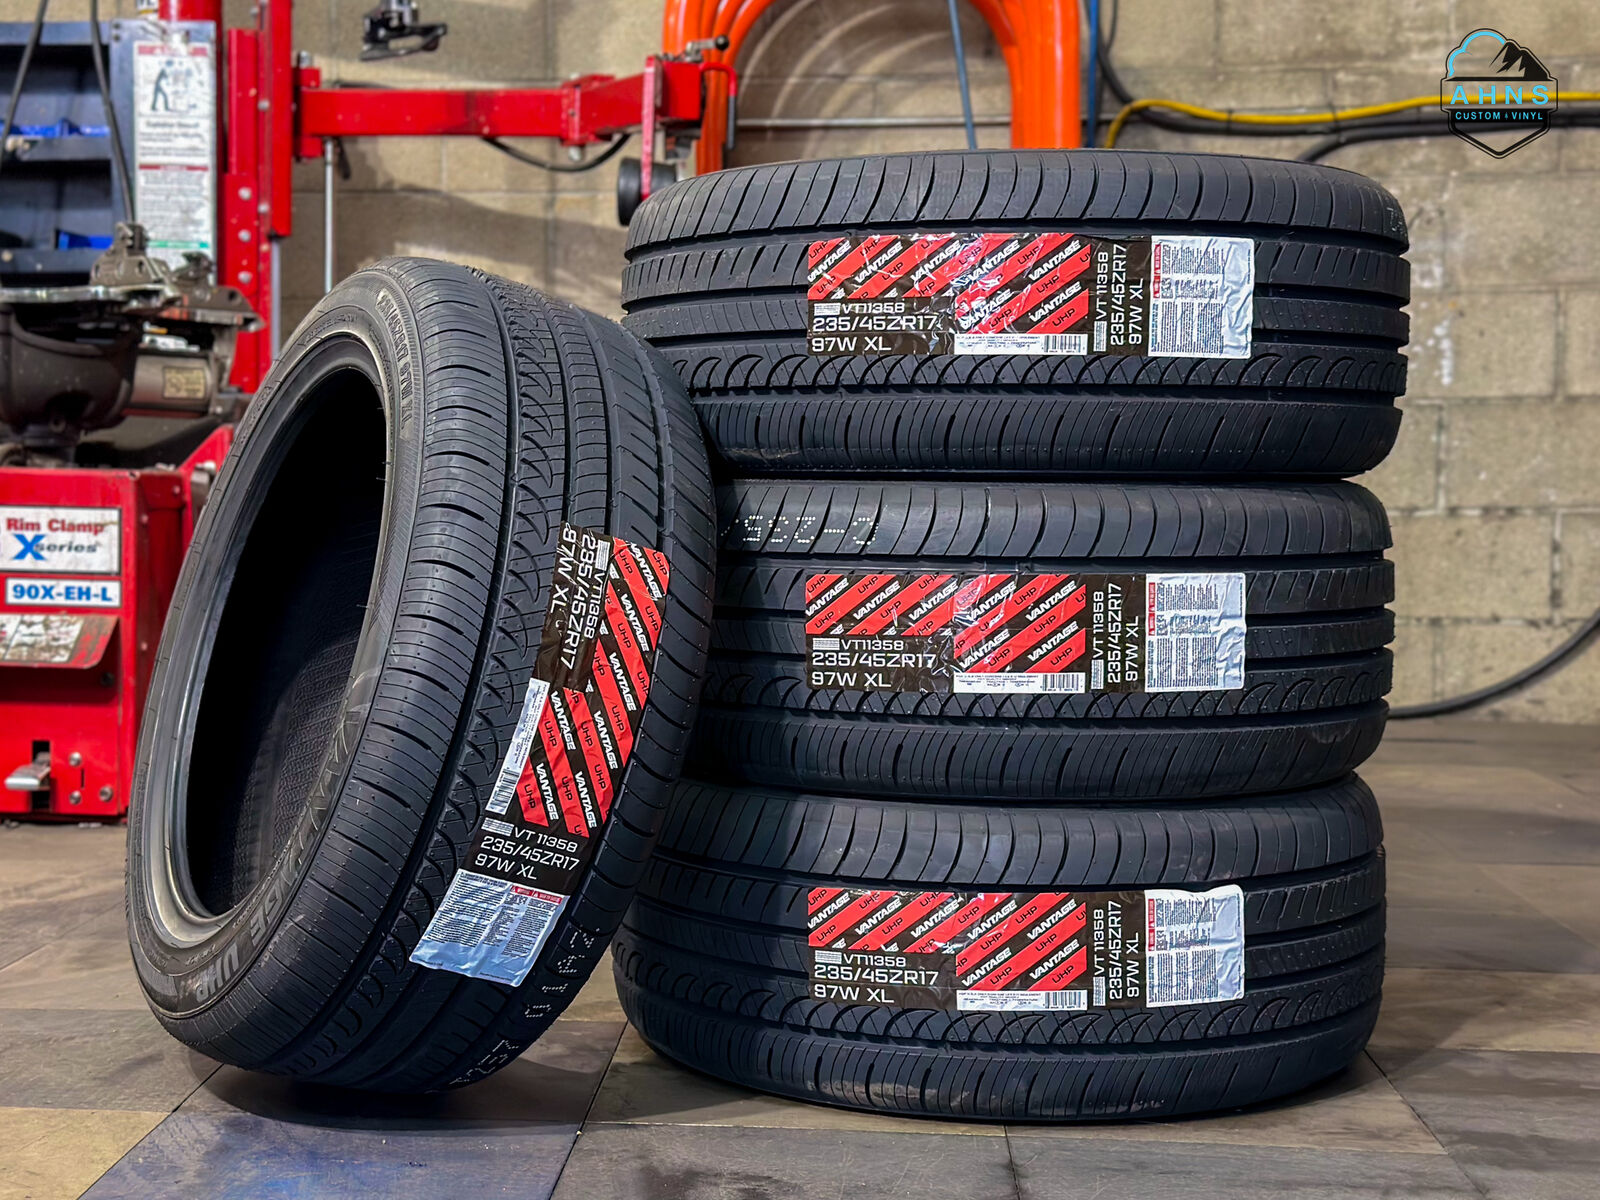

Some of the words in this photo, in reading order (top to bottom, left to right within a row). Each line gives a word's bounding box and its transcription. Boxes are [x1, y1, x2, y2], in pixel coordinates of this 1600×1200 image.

[807, 240, 851, 282] VANTAGE
[809, 241, 827, 259] UHP
[855, 241, 903, 283] VANTAGE
[910, 240, 961, 282] VANTAGE
[968, 240, 1020, 282] VANTAGE
[1017, 245, 1040, 265] UHP
[1028, 240, 1081, 280] VANTAGE
[882, 262, 903, 280] UHP
[1036, 274, 1060, 293] UHP
[817, 275, 836, 294] UHP
[1111, 244, 1127, 346] 235/45ZR17
[1129, 278, 1143, 300] XL
[1029, 281, 1081, 322] VANTAGE
[813, 316, 937, 332] 235/45ZR17
[1052, 308, 1075, 326] UHP
[1129, 306, 1142, 345] 97W
[812, 337, 857, 352] 97W
[864, 336, 892, 351] XL
[6, 518, 40, 531] Rim
[48, 519, 105, 535] Clamp
[557, 528, 577, 583] 97W
[620, 549, 633, 574] UHP
[630, 541, 662, 599] VANTAGE
[12, 584, 112, 602] 90X-EH-L
[805, 577, 849, 617] VANTAGE
[807, 576, 826, 593] UHP
[858, 576, 878, 594] UHP
[1014, 587, 1037, 606] UHP
[550, 584, 569, 613] XL
[561, 535, 596, 670] 235/45ZR17
[853, 581, 900, 620] VANTAGE
[880, 601, 902, 619] UHP
[909, 579, 959, 620] VANTAGE
[967, 581, 1017, 621] VANTAGE
[1026, 581, 1077, 621] VANTAGE
[621, 594, 650, 651] VANTAGE
[645, 606, 659, 631] UHP
[815, 611, 834, 629] UHP
[1034, 615, 1057, 634] UHP
[1126, 616, 1139, 638] XL
[618, 623, 631, 648] UHP
[1028, 621, 1079, 661] VANTAGE
[1108, 583, 1122, 683] 235/45ZR17
[812, 653, 936, 668] 235/45ZR17
[959, 629, 1011, 669] VANTAGE
[988, 648, 1011, 666] UHP
[1050, 647, 1073, 666] UHP
[1126, 644, 1138, 682] 97W
[609, 652, 637, 711] VANTAGE
[812, 672, 857, 686] 97W
[864, 673, 891, 687] XL
[550, 691, 576, 750] VANTAGE
[611, 705, 624, 731] UHP
[544, 721, 557, 747] UHP
[581, 721, 593, 747] UHP
[593, 710, 618, 770] VANTAGE
[561, 776, 573, 801] UHP
[594, 764, 606, 789] UHP
[524, 784, 536, 809] UHP
[536, 763, 559, 820] VANTAGE
[575, 771, 597, 828] VANTAGE
[475, 853, 515, 873] 97W
[517, 864, 537, 880] XL
[480, 836, 580, 871] 235/45ZR17
[808, 892, 850, 929] VANTAGE
[809, 889, 827, 906] UHP
[855, 897, 902, 935] VANTAGE
[882, 918, 903, 935] UHP
[911, 899, 960, 938] VANTAGE
[958, 906, 980, 924] UHP
[967, 900, 1018, 940] VANTAGE
[1016, 906, 1038, 924] UHP
[1027, 899, 1077, 940] VANTAGE
[816, 925, 837, 942] UHP
[980, 932, 1003, 950] UHP
[1036, 933, 1057, 952] UHP
[1126, 932, 1139, 954] XL
[1029, 939, 1079, 980] VANTAGE
[1108, 901, 1122, 1000] 235/45ZR17
[815, 965, 939, 985] 235/45ZR17
[962, 947, 1012, 987] VANTAGE
[990, 967, 1013, 985] UHP
[1052, 965, 1074, 984] UHP
[1127, 961, 1139, 997] 97W
[815, 984, 860, 1000] 97W
[867, 988, 894, 1003] XL
